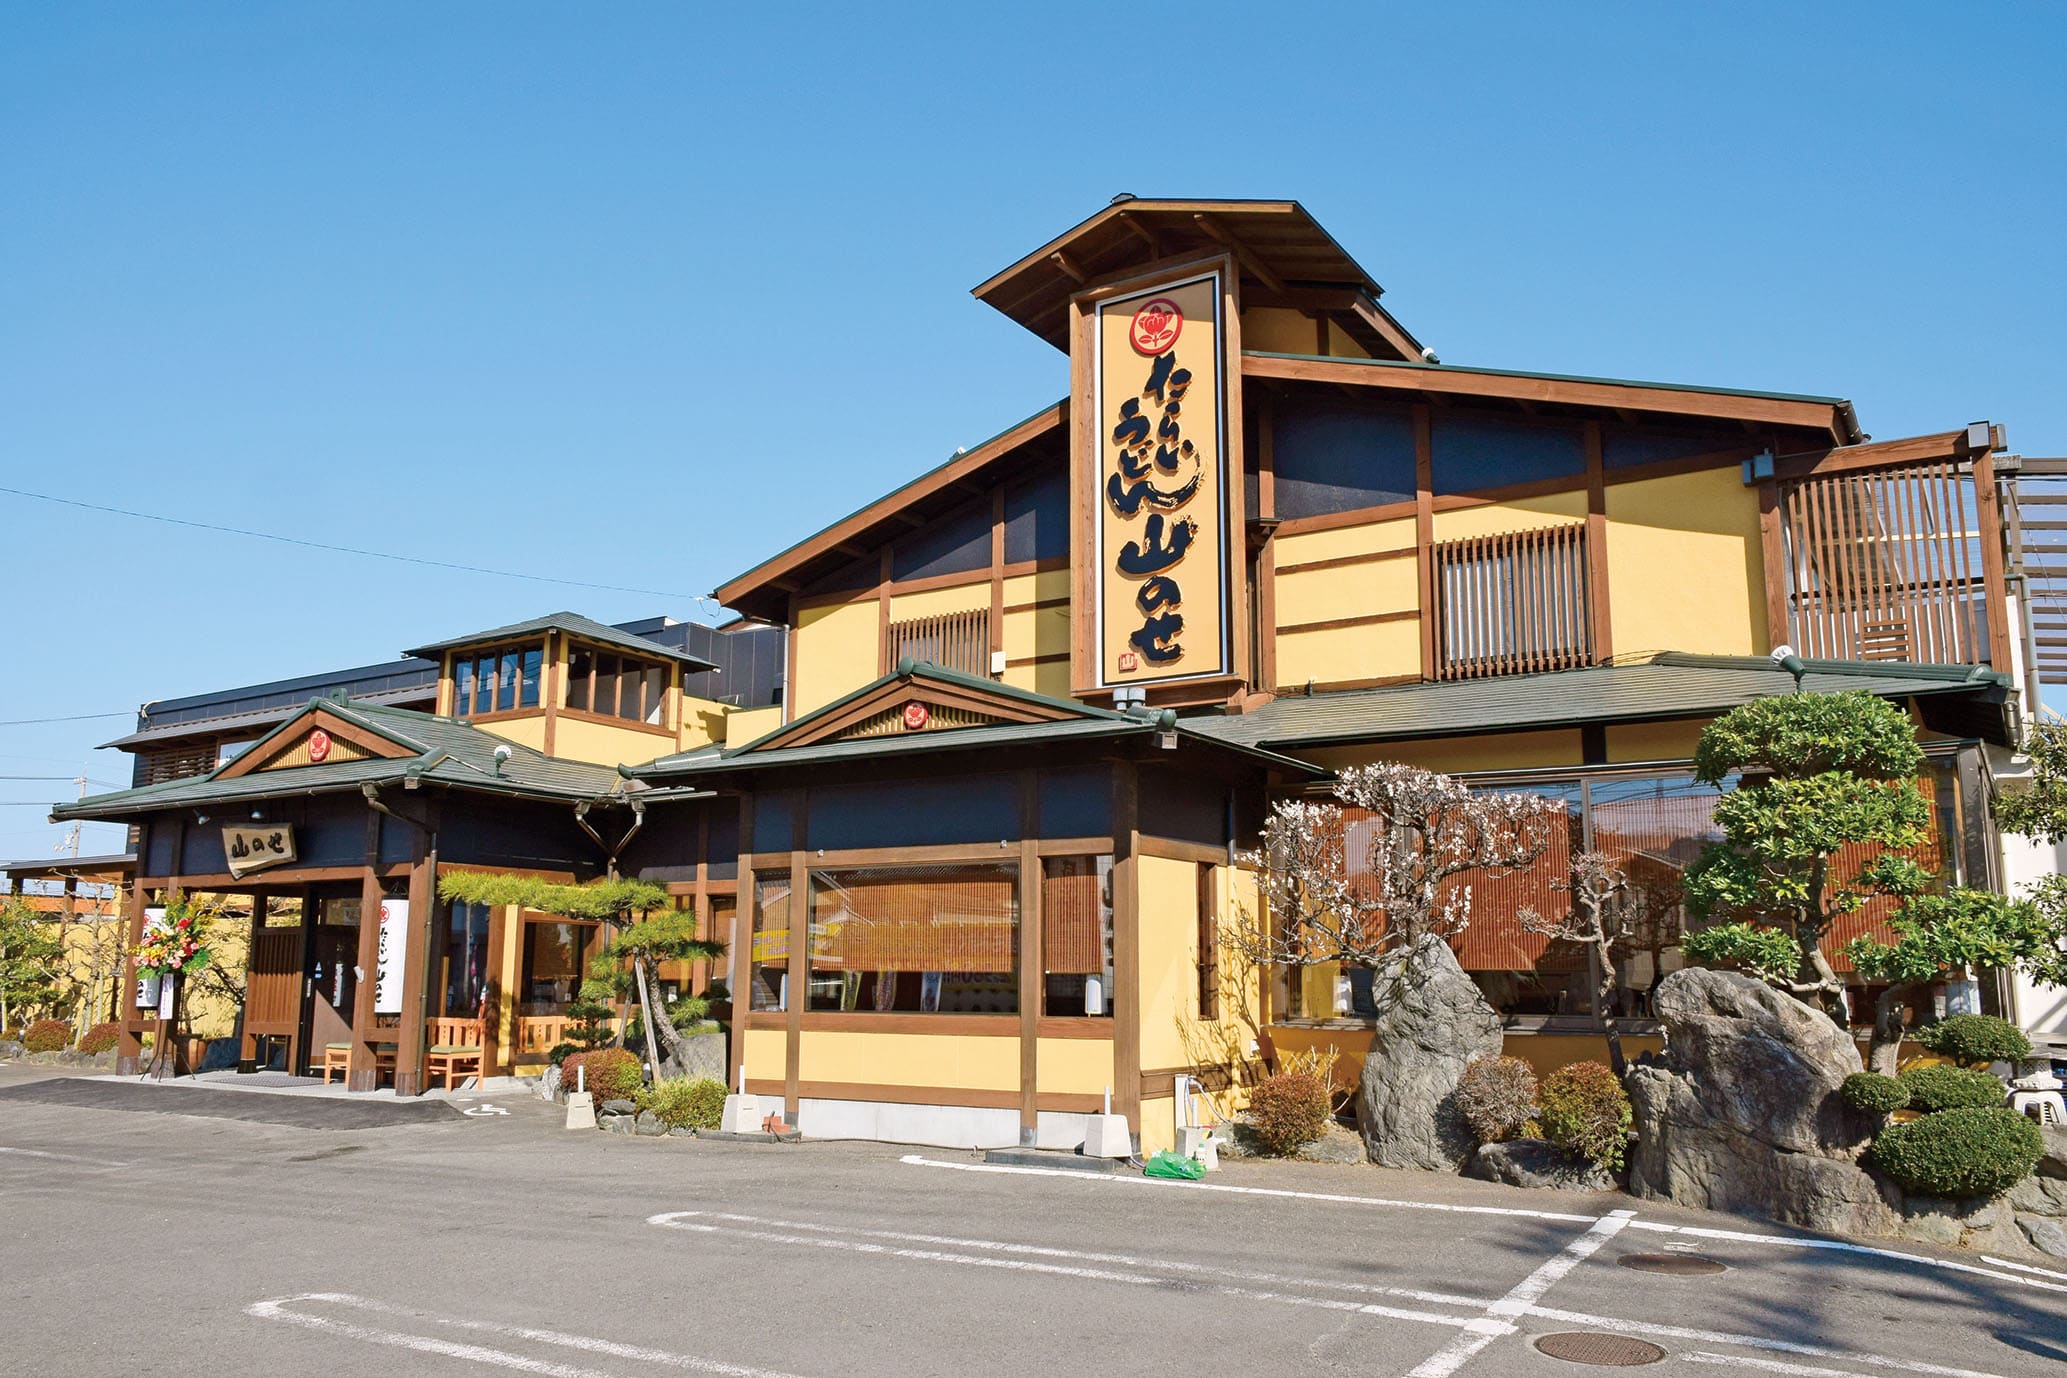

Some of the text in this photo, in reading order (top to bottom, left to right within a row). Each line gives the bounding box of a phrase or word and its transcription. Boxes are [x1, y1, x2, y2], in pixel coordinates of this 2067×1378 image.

[1117, 513, 1199, 662] 山のせ
[231, 832, 285, 858] 山のせ
